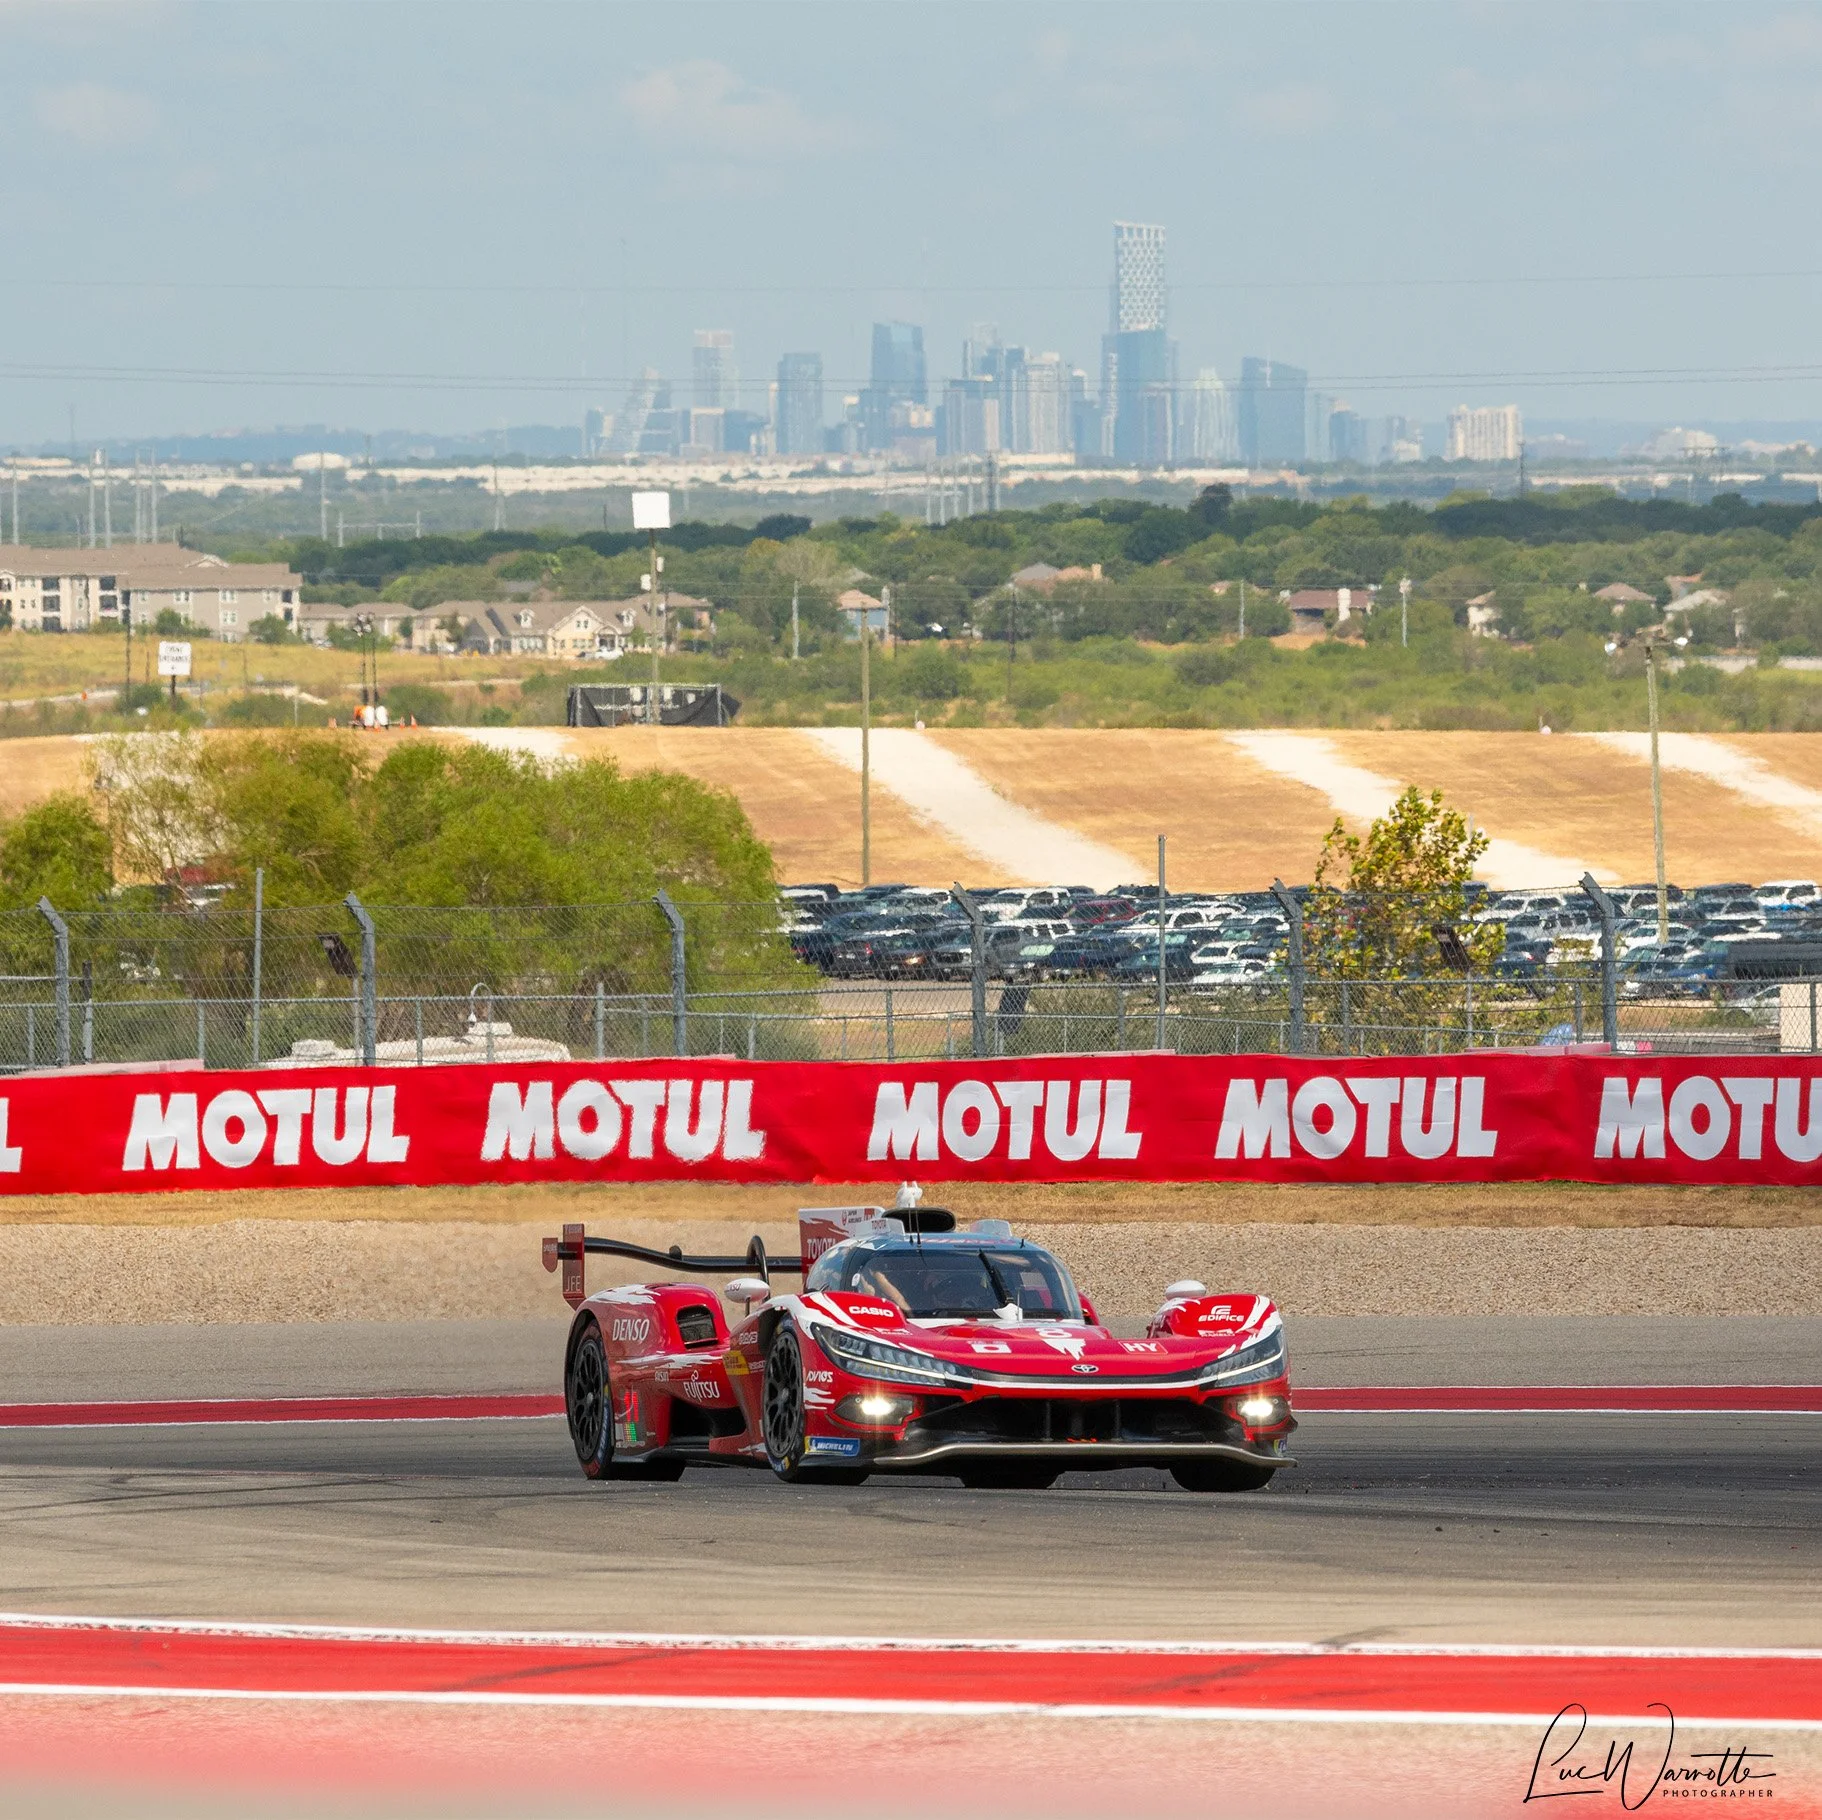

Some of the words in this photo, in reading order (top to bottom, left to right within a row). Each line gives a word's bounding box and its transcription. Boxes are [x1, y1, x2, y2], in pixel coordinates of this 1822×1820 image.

[481, 1079, 765, 1162] MOTUL
[868, 1080, 1143, 1162] MOTUL
[1215, 1076, 1498, 1160] MOTUL
[123, 1085, 410, 1172] MOTUL
[565, 1275, 581, 1292] JFE
[848, 1305, 895, 1318] CASIO
[1198, 1314, 1245, 1322] EDIFICE
[612, 1318, 650, 1341] DENSO
[1036, 1327, 1073, 1338] 8
[1125, 1341, 1158, 1352] HY
[683, 1380, 720, 1402] FUJITSU
[816, 1442, 854, 1451] MICHELIN
